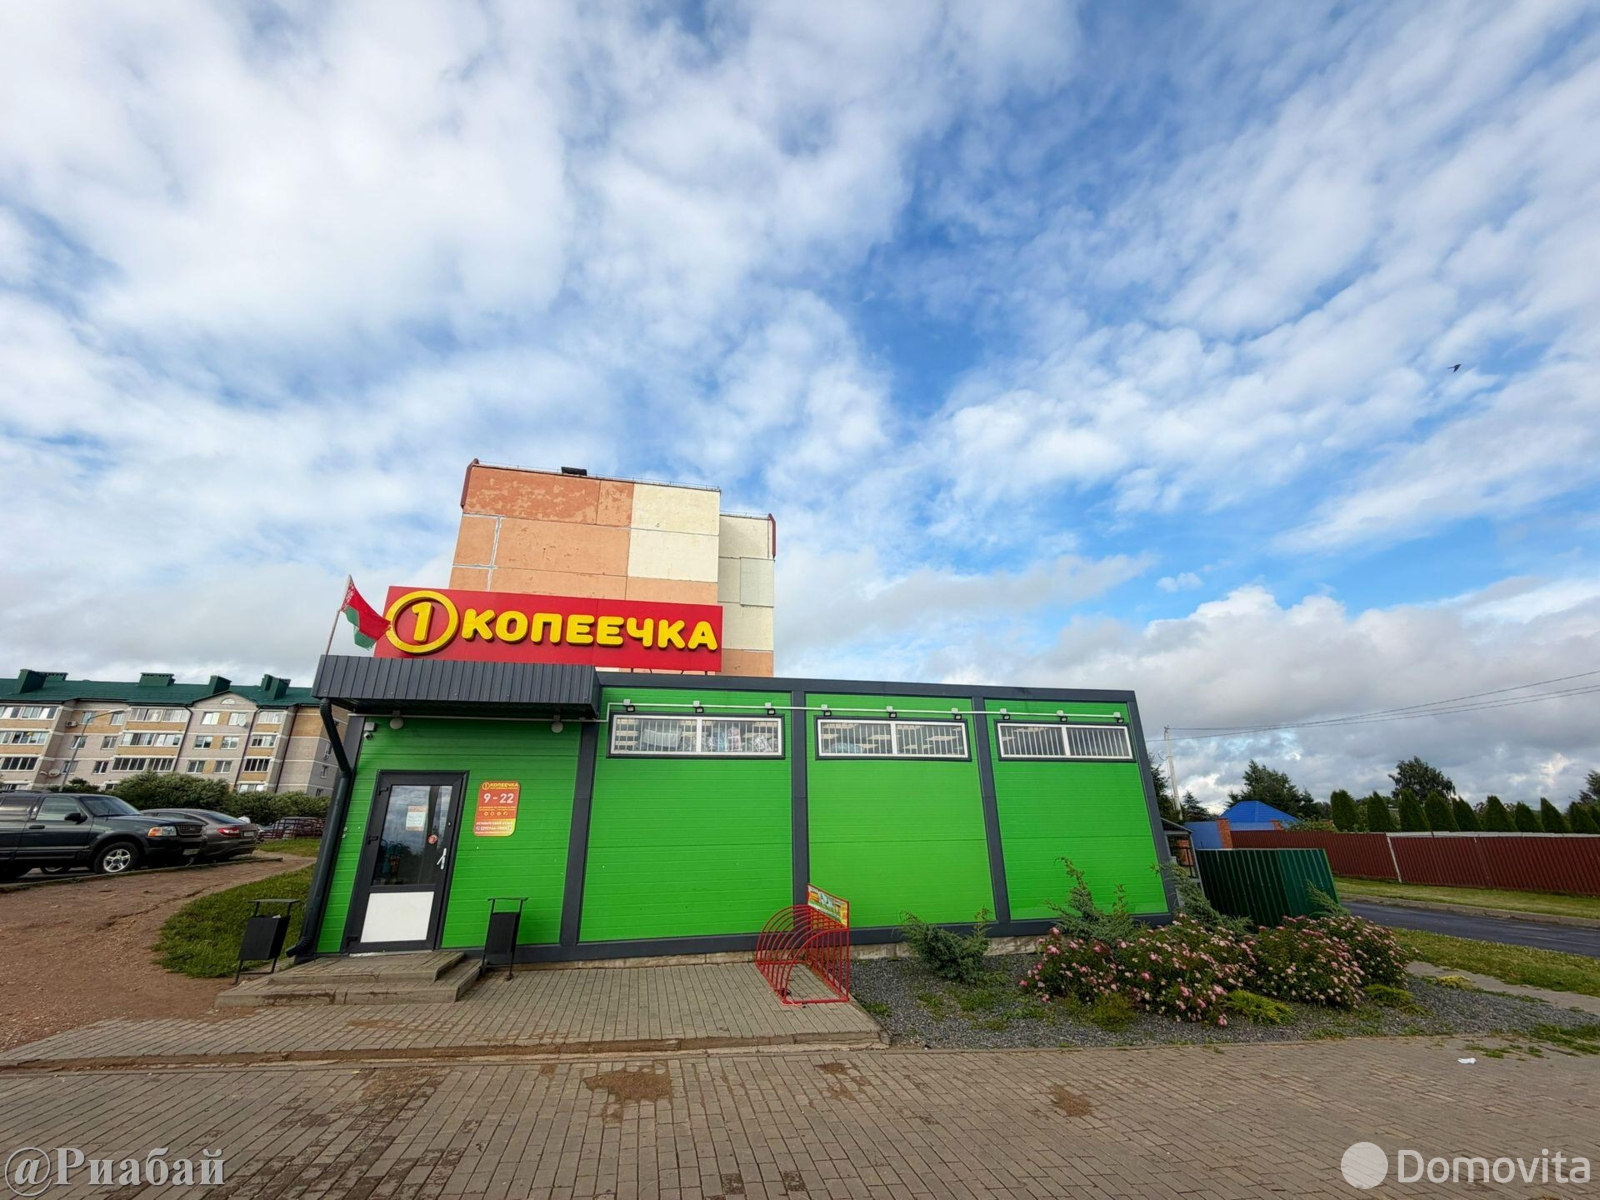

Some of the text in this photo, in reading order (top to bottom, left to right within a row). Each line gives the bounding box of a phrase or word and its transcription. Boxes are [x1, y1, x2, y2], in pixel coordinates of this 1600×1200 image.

[461, 608, 718, 651] КОПЕЕЧКА
[483, 792, 491, 804] 9
[499, 792, 514, 804] 22
